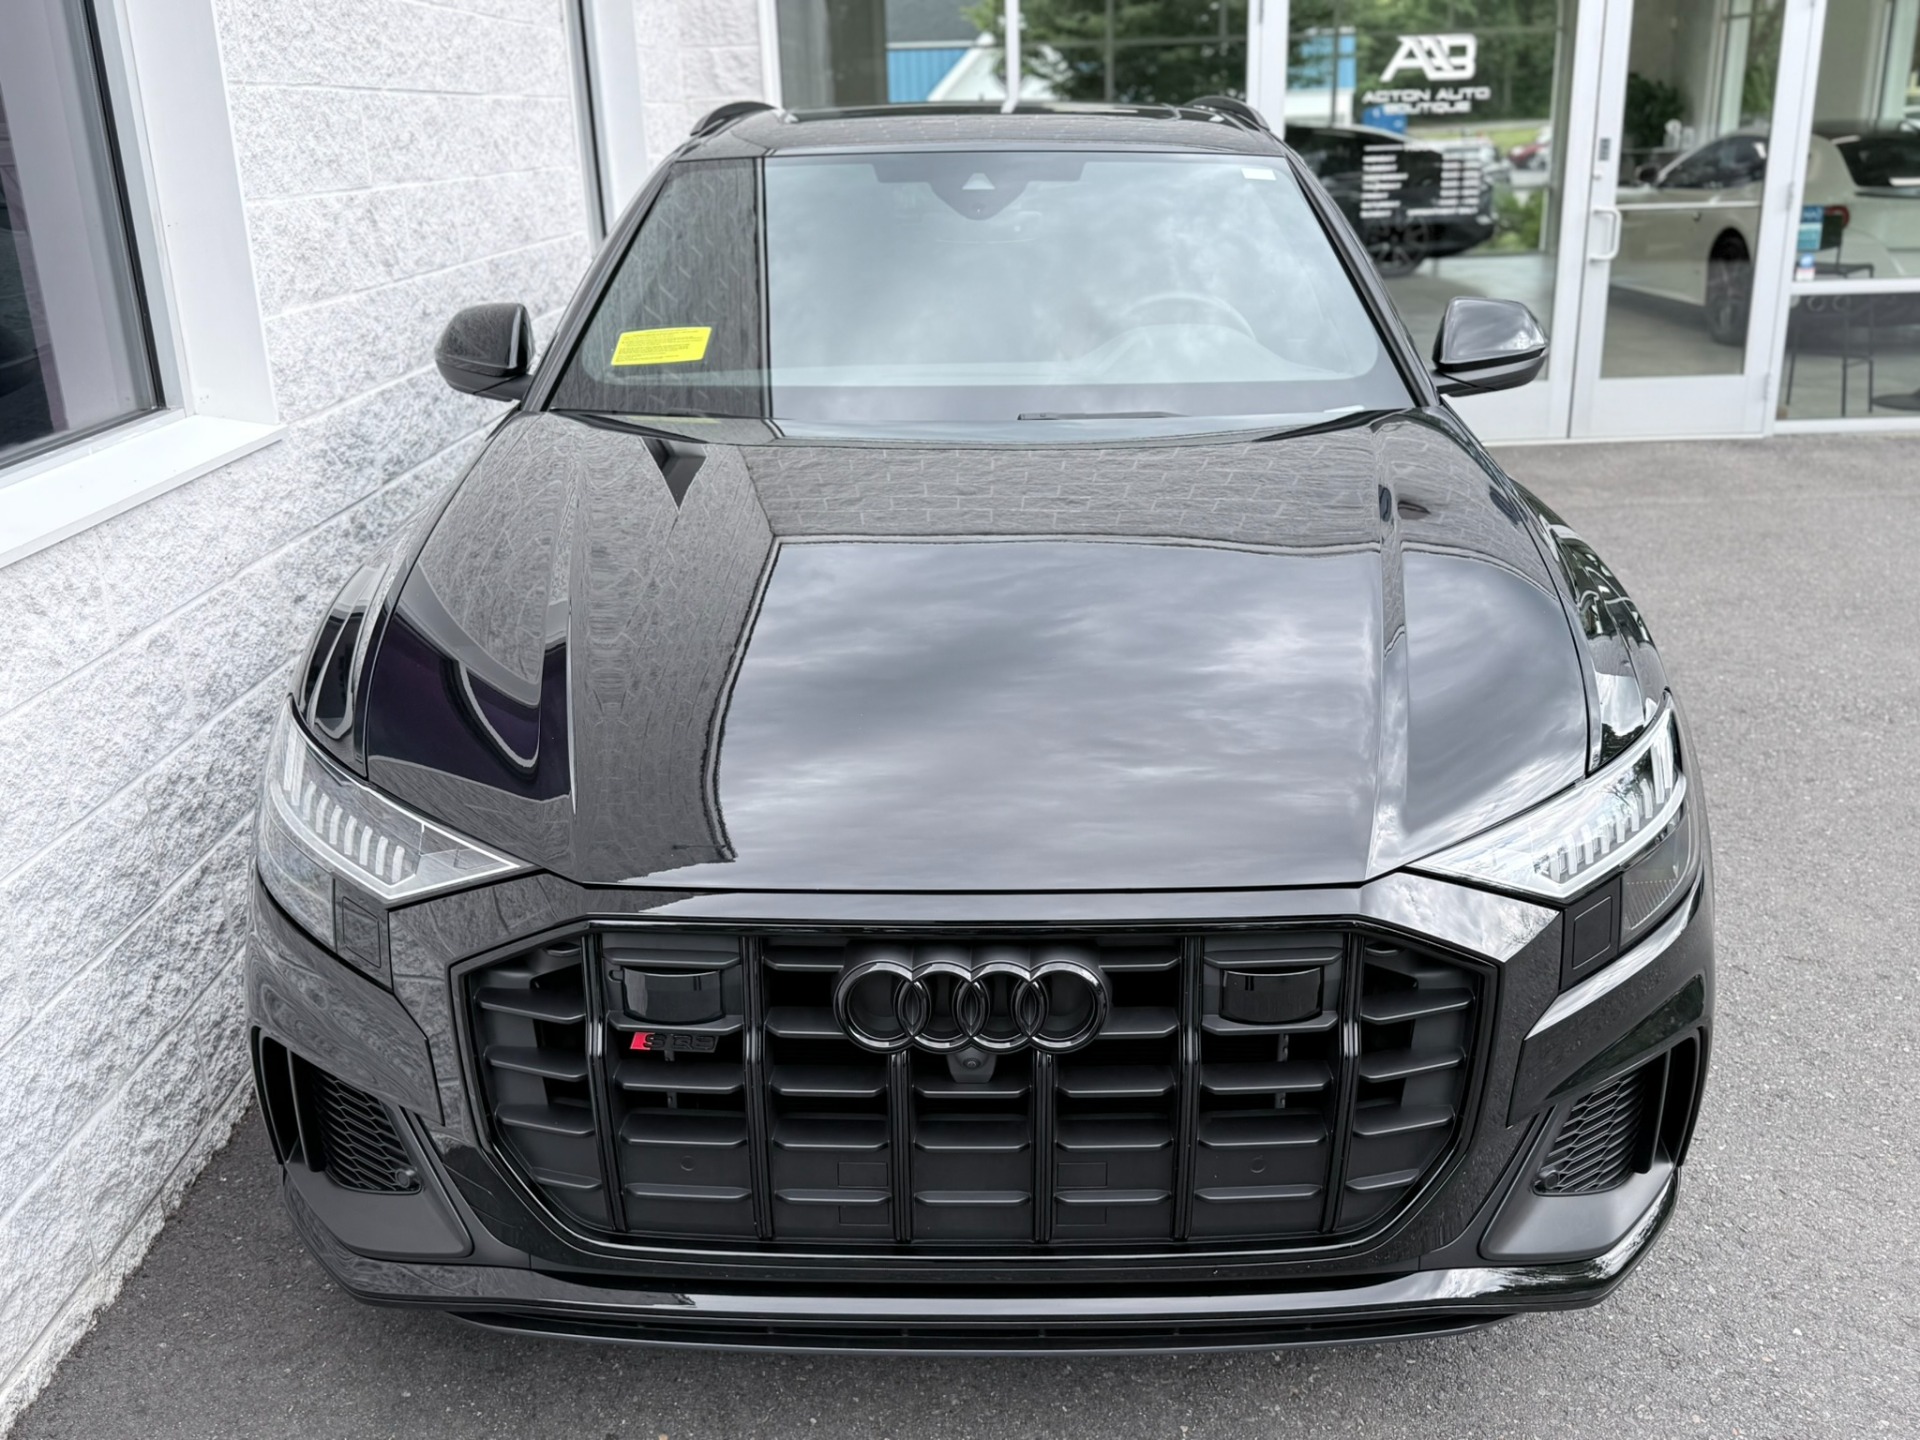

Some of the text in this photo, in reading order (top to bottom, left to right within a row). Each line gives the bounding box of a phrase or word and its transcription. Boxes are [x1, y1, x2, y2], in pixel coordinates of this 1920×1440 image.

[1362, 86, 1491, 103] ACTON AUTO
[1383, 101, 1471, 115] BOUTIQUE
